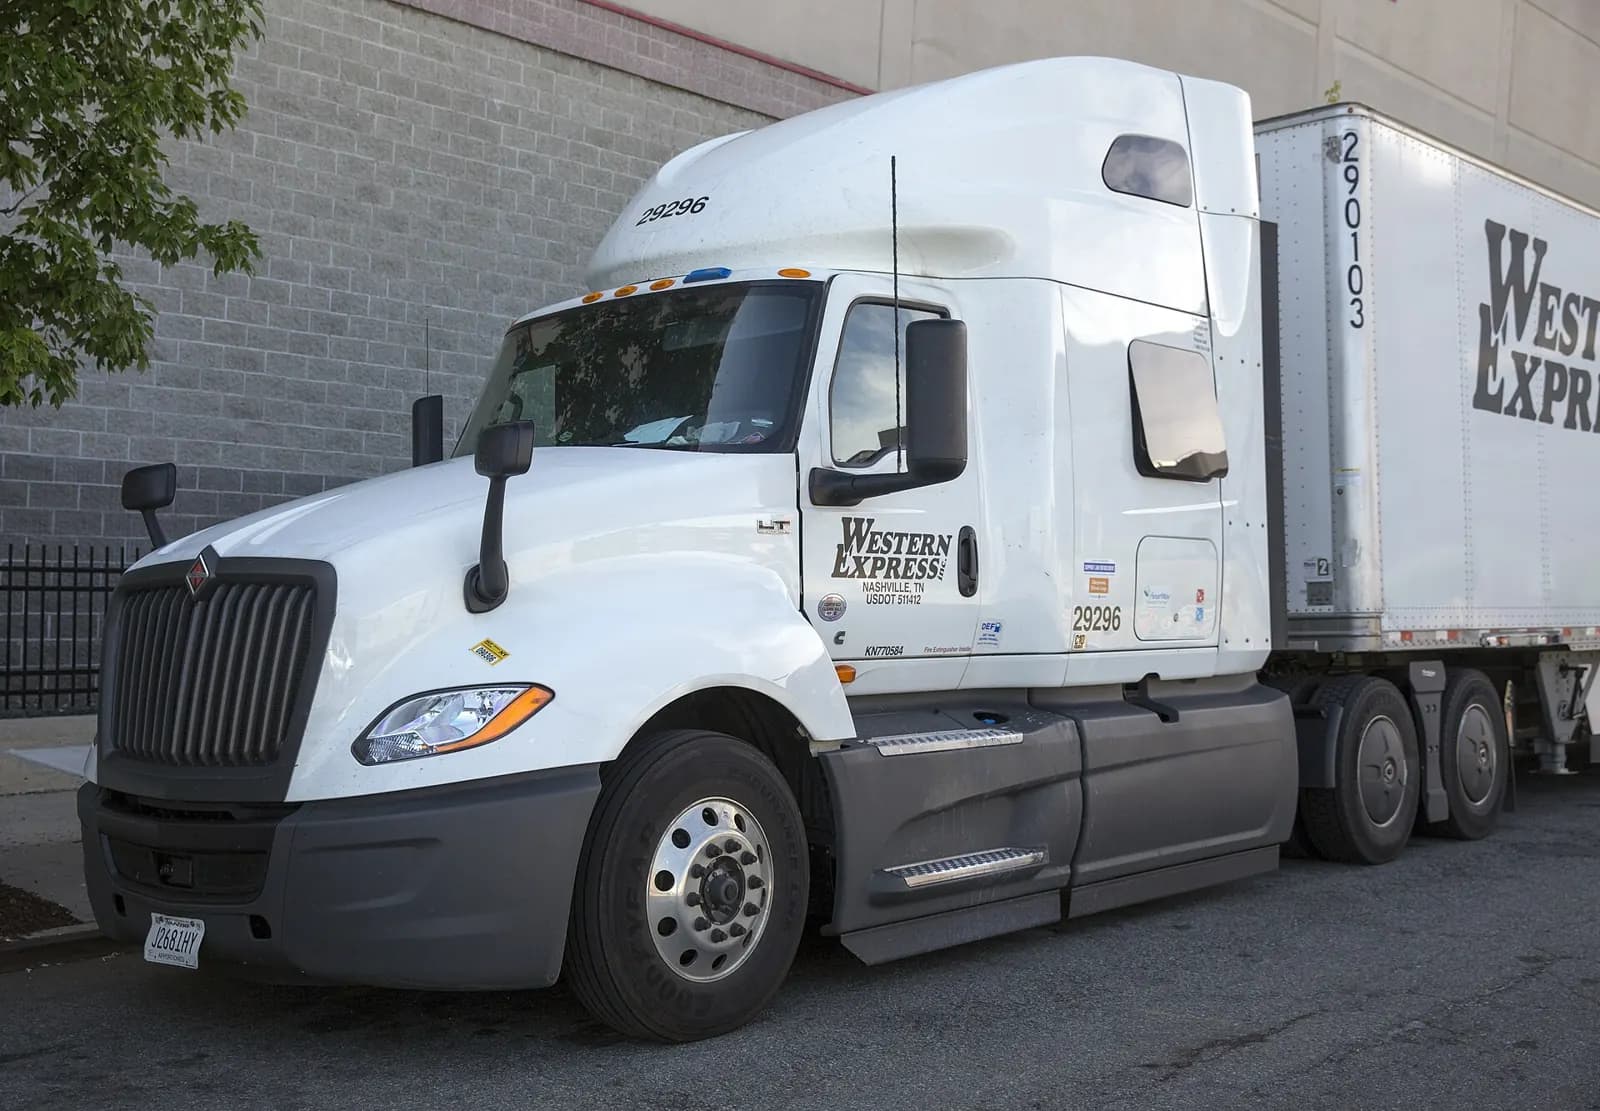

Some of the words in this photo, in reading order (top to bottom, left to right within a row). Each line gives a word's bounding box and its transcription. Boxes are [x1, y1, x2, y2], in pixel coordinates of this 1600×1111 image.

[635, 196, 709, 227] 29296
[1342, 131, 1365, 329] 290103
[1472, 302, 1600, 434] EXPR
[758, 520, 791, 530] LT
[841, 516, 953, 557] WESTERN
[831, 543, 940, 580] EXPRESS
[862, 581, 912, 593] NASHVILLE,
[914, 582, 925, 593] TN
[866, 593, 896, 605] USDOT
[897, 594, 922, 605] 511412
[1073, 605, 1121, 632] 29296
[864, 645, 904, 657] KN770584
[151, 926, 198, 955] J2681HY
